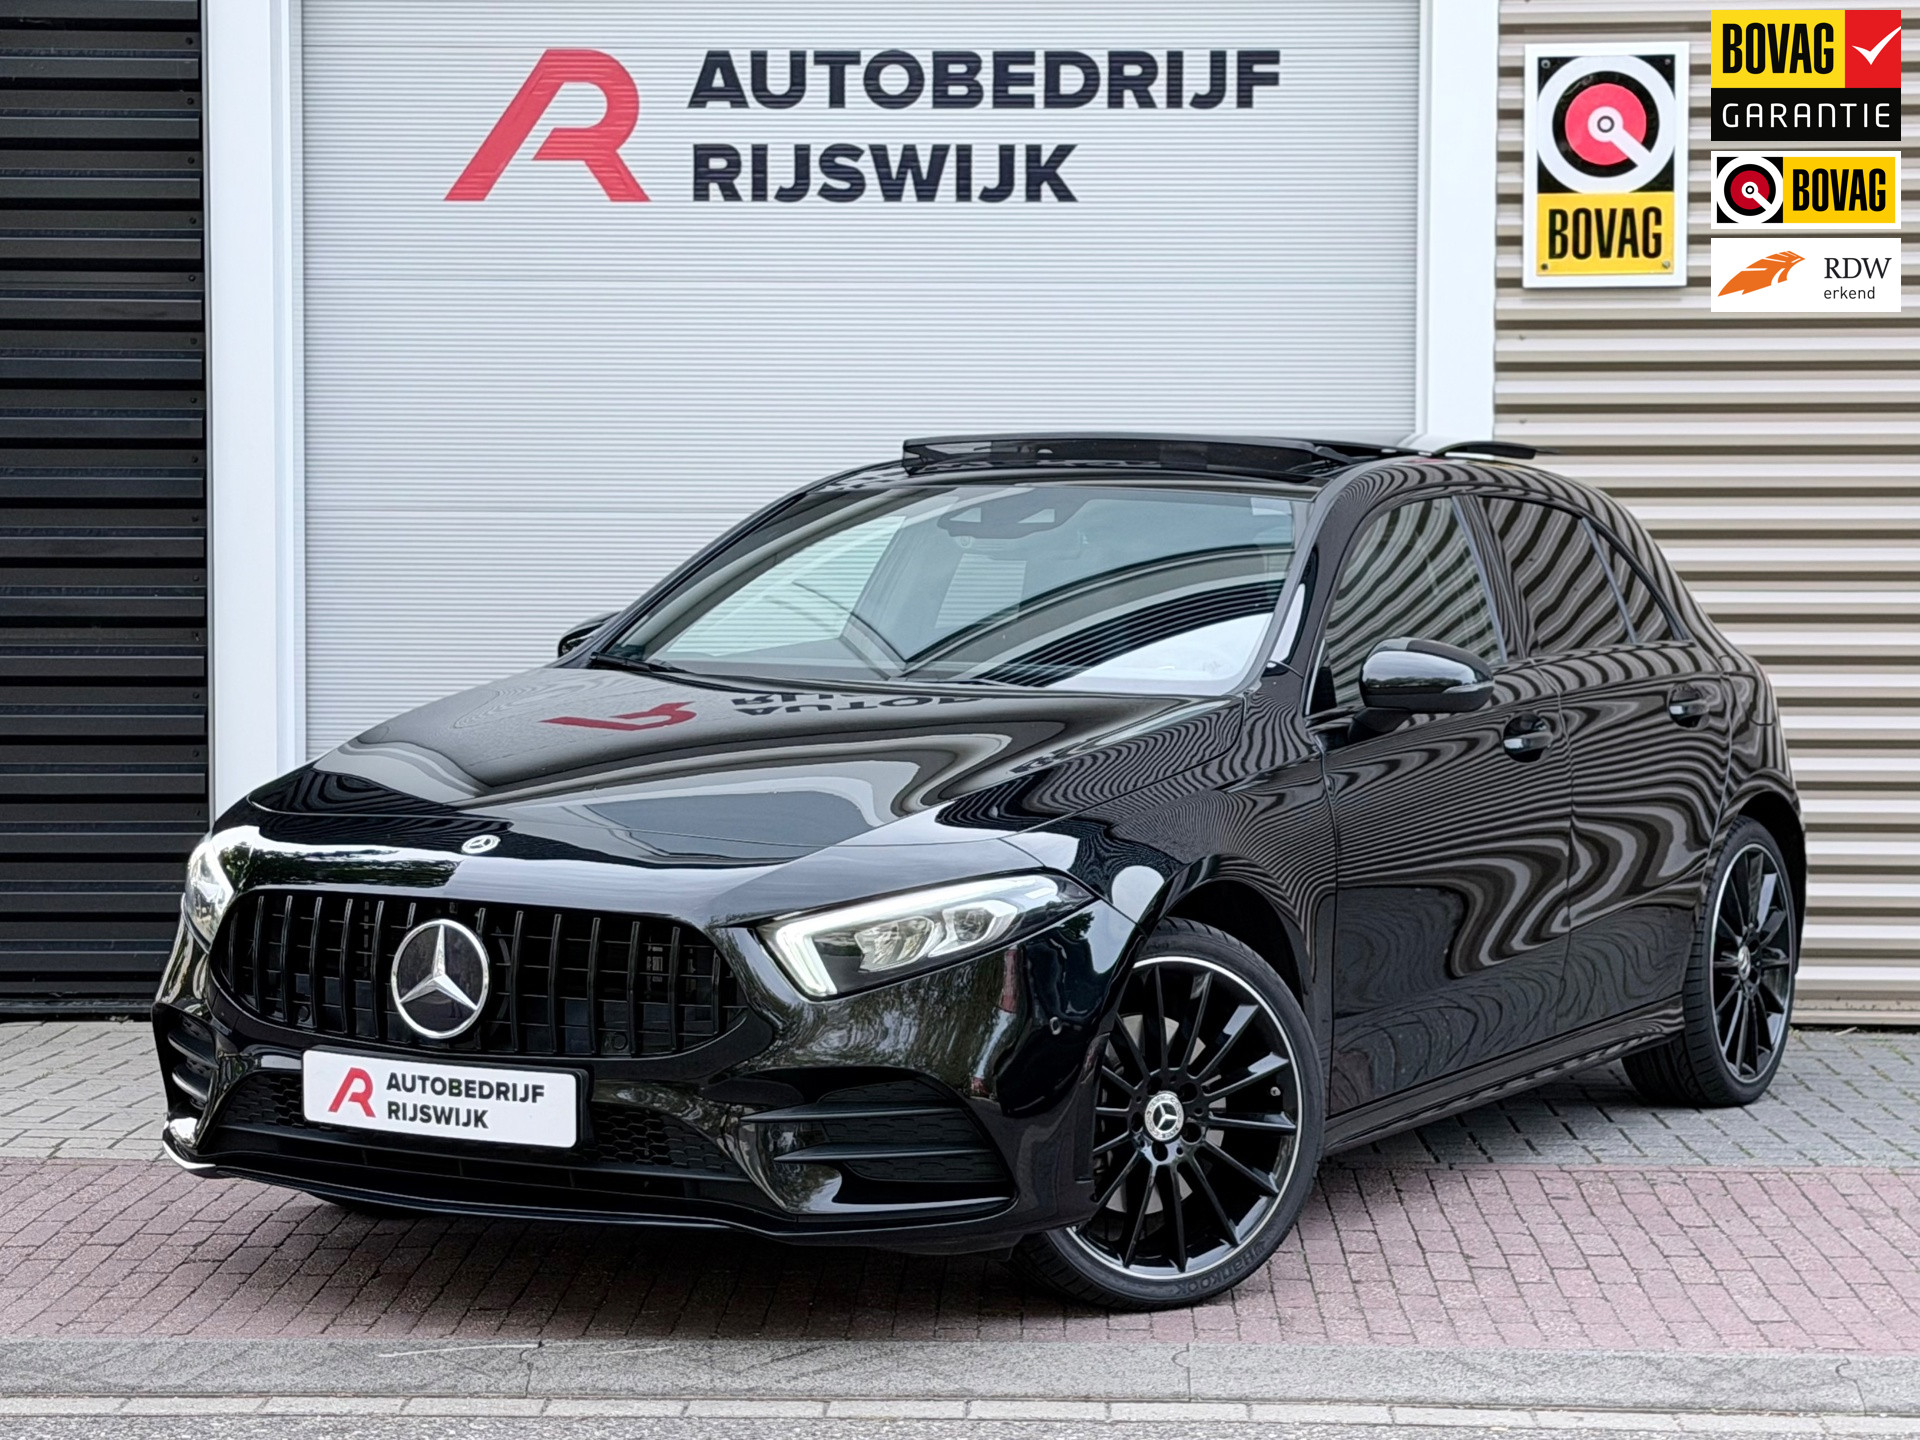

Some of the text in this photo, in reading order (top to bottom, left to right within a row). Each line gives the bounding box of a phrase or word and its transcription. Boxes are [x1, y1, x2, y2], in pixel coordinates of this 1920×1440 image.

[688, 49, 1280, 110] AUTOBEDRIJF
[692, 143, 1078, 203] RIJSWIJK
[1548, 206, 1662, 260] BOVAG
[386, 1072, 545, 1103] AUTOBEDRIJF
[387, 1101, 489, 1129] RIJSWIJK
